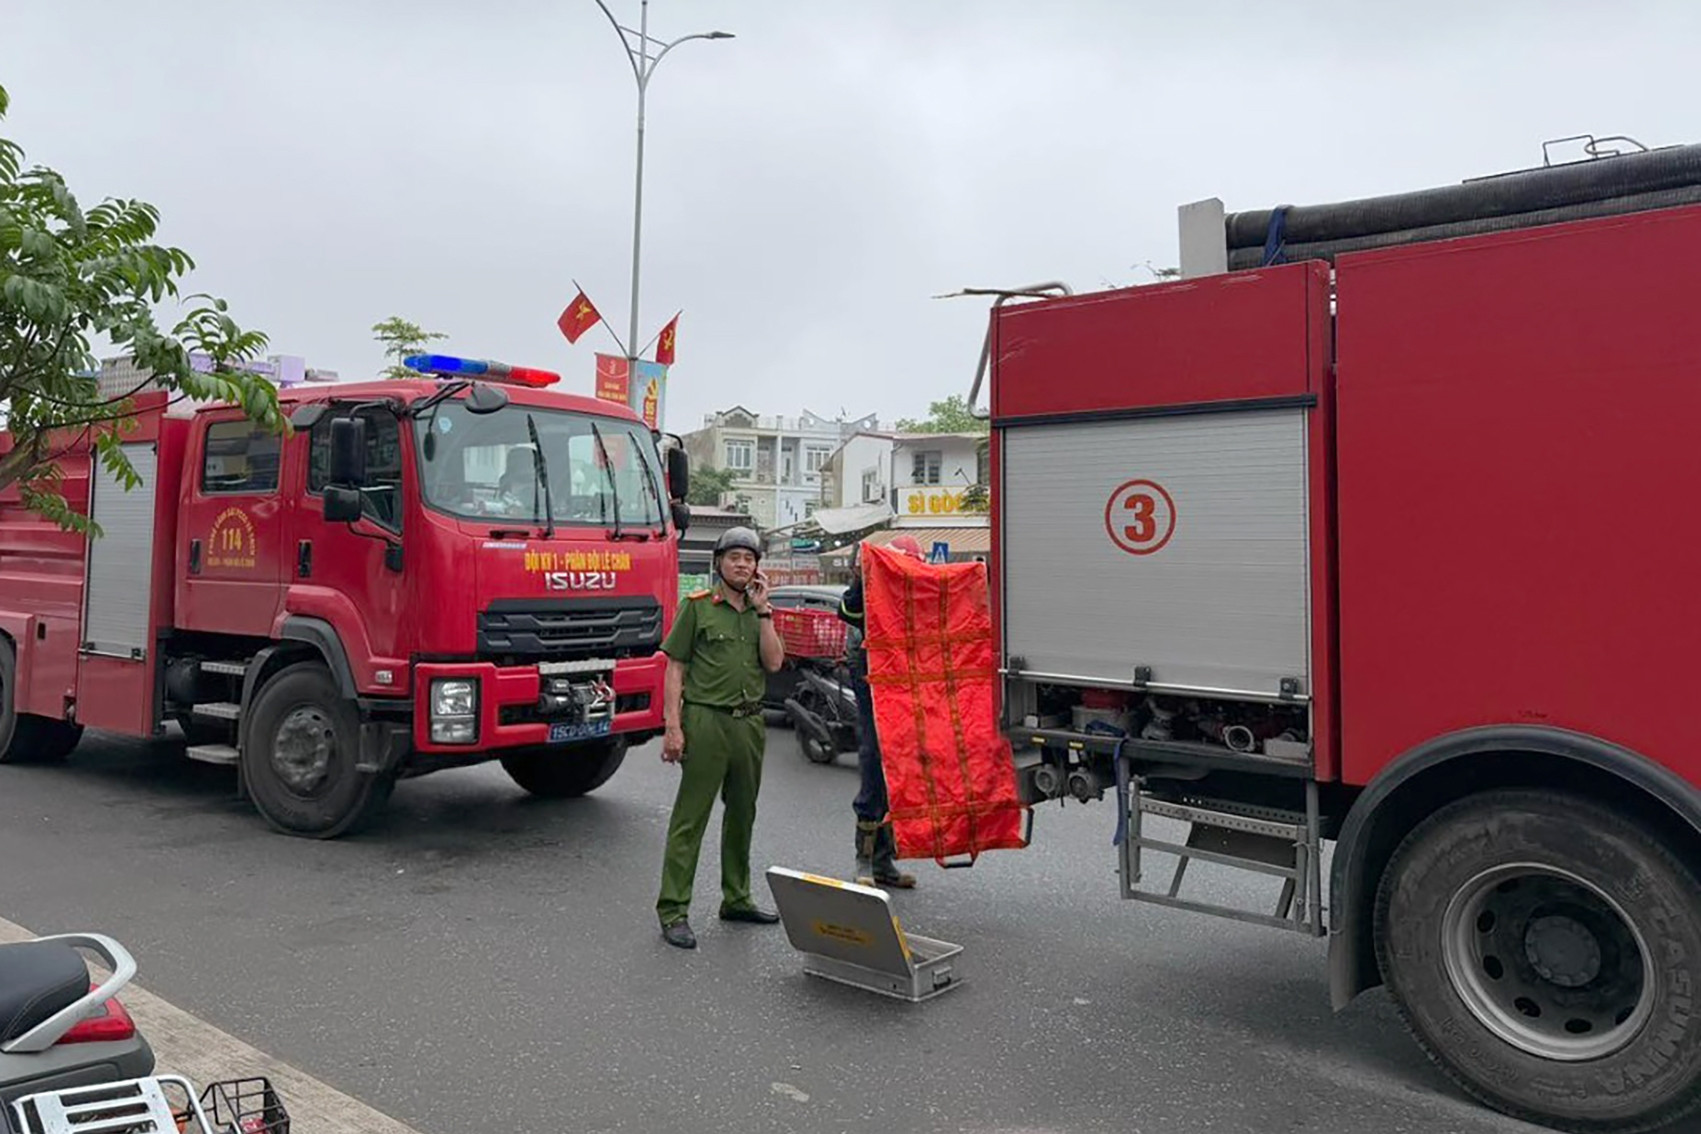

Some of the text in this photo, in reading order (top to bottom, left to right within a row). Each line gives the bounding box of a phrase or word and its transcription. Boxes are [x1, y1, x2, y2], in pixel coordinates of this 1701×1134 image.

[1124, 493, 1156, 543] 3
[222, 528, 242, 550] 114
[544, 571, 616, 590] ISUZU
